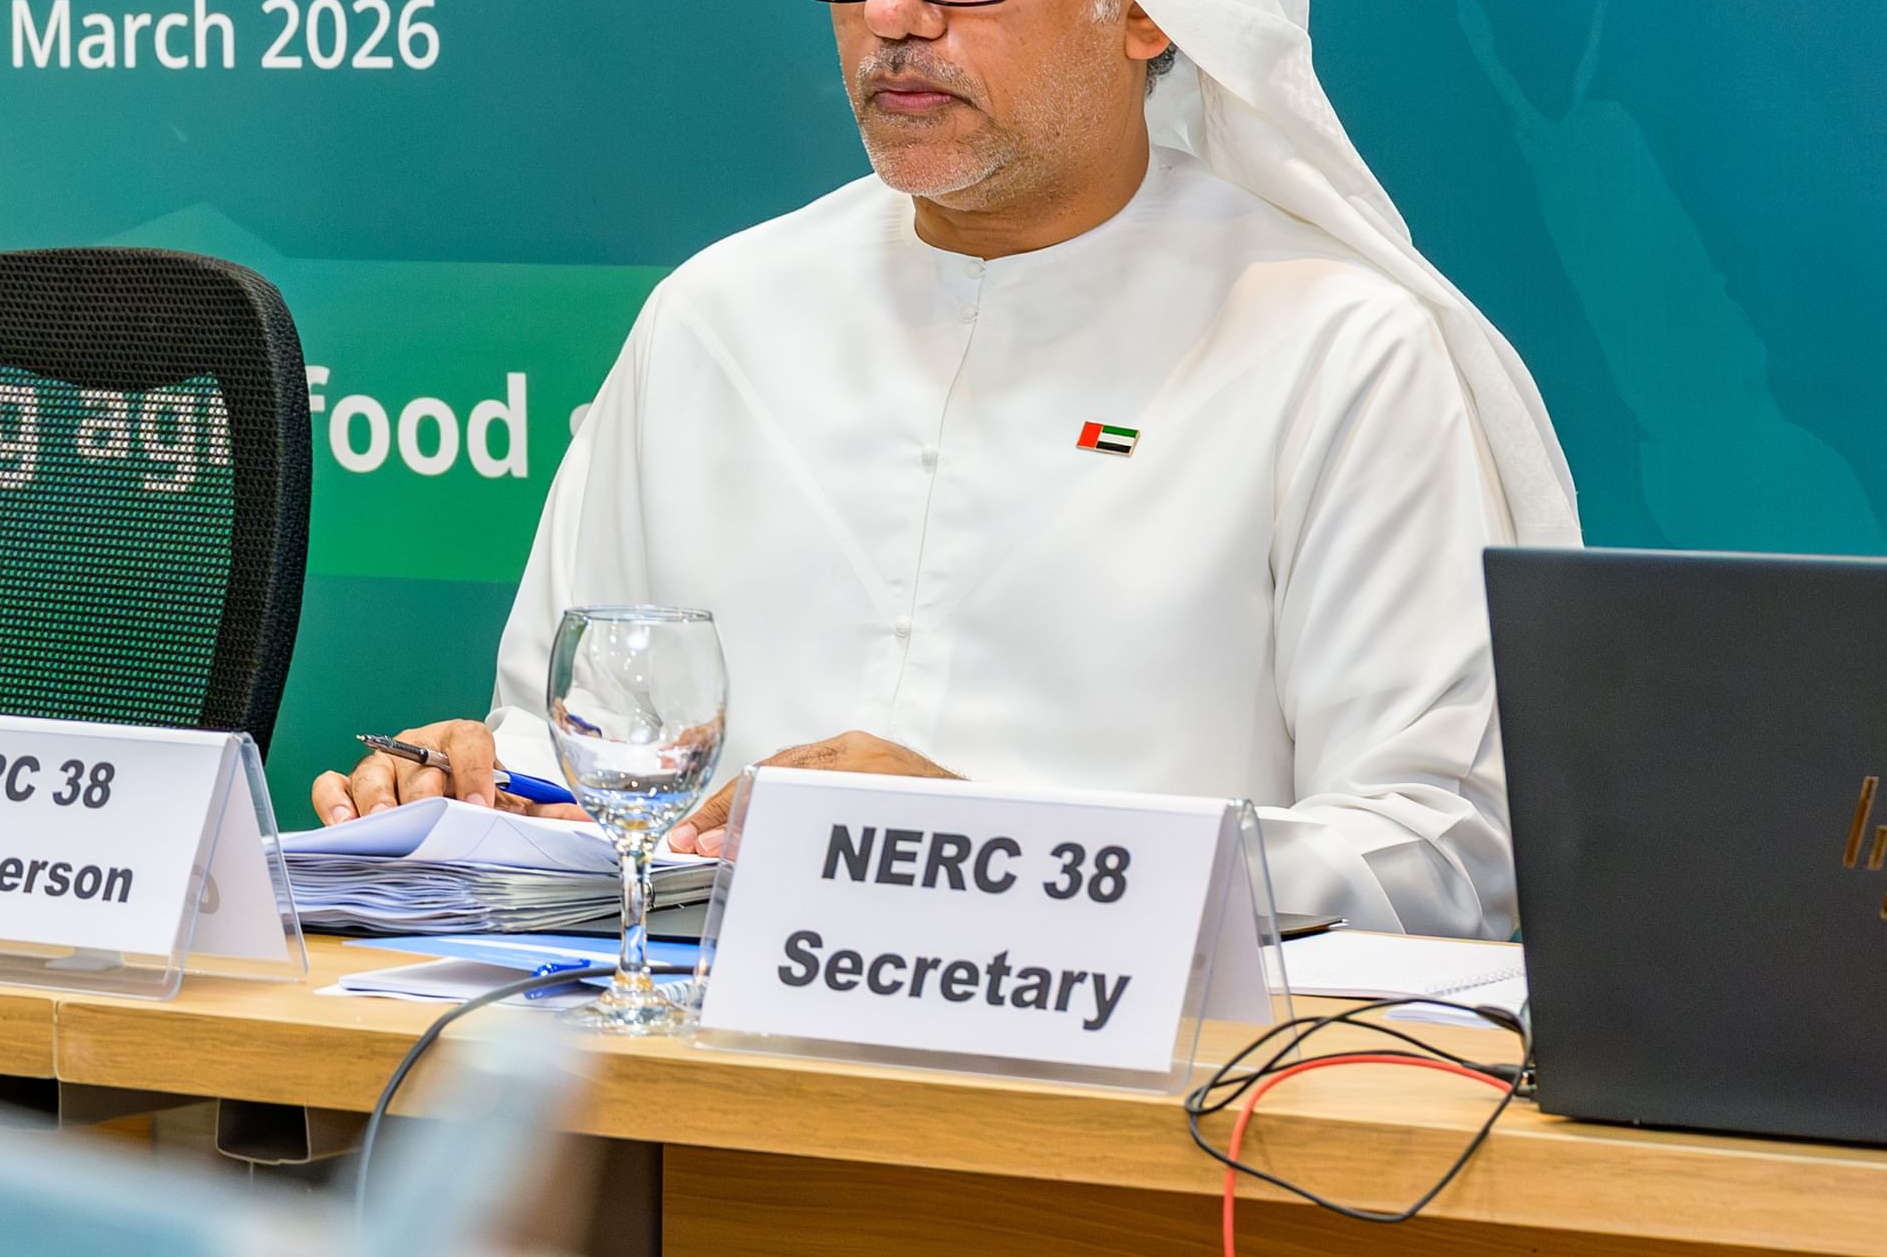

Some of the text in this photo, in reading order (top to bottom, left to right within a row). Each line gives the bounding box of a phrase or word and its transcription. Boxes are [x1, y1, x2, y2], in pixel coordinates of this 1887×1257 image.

[53, 760, 115, 808] 38
[822, 824, 1131, 903] NERC 38
[777, 930, 1131, 1031] Secretary
